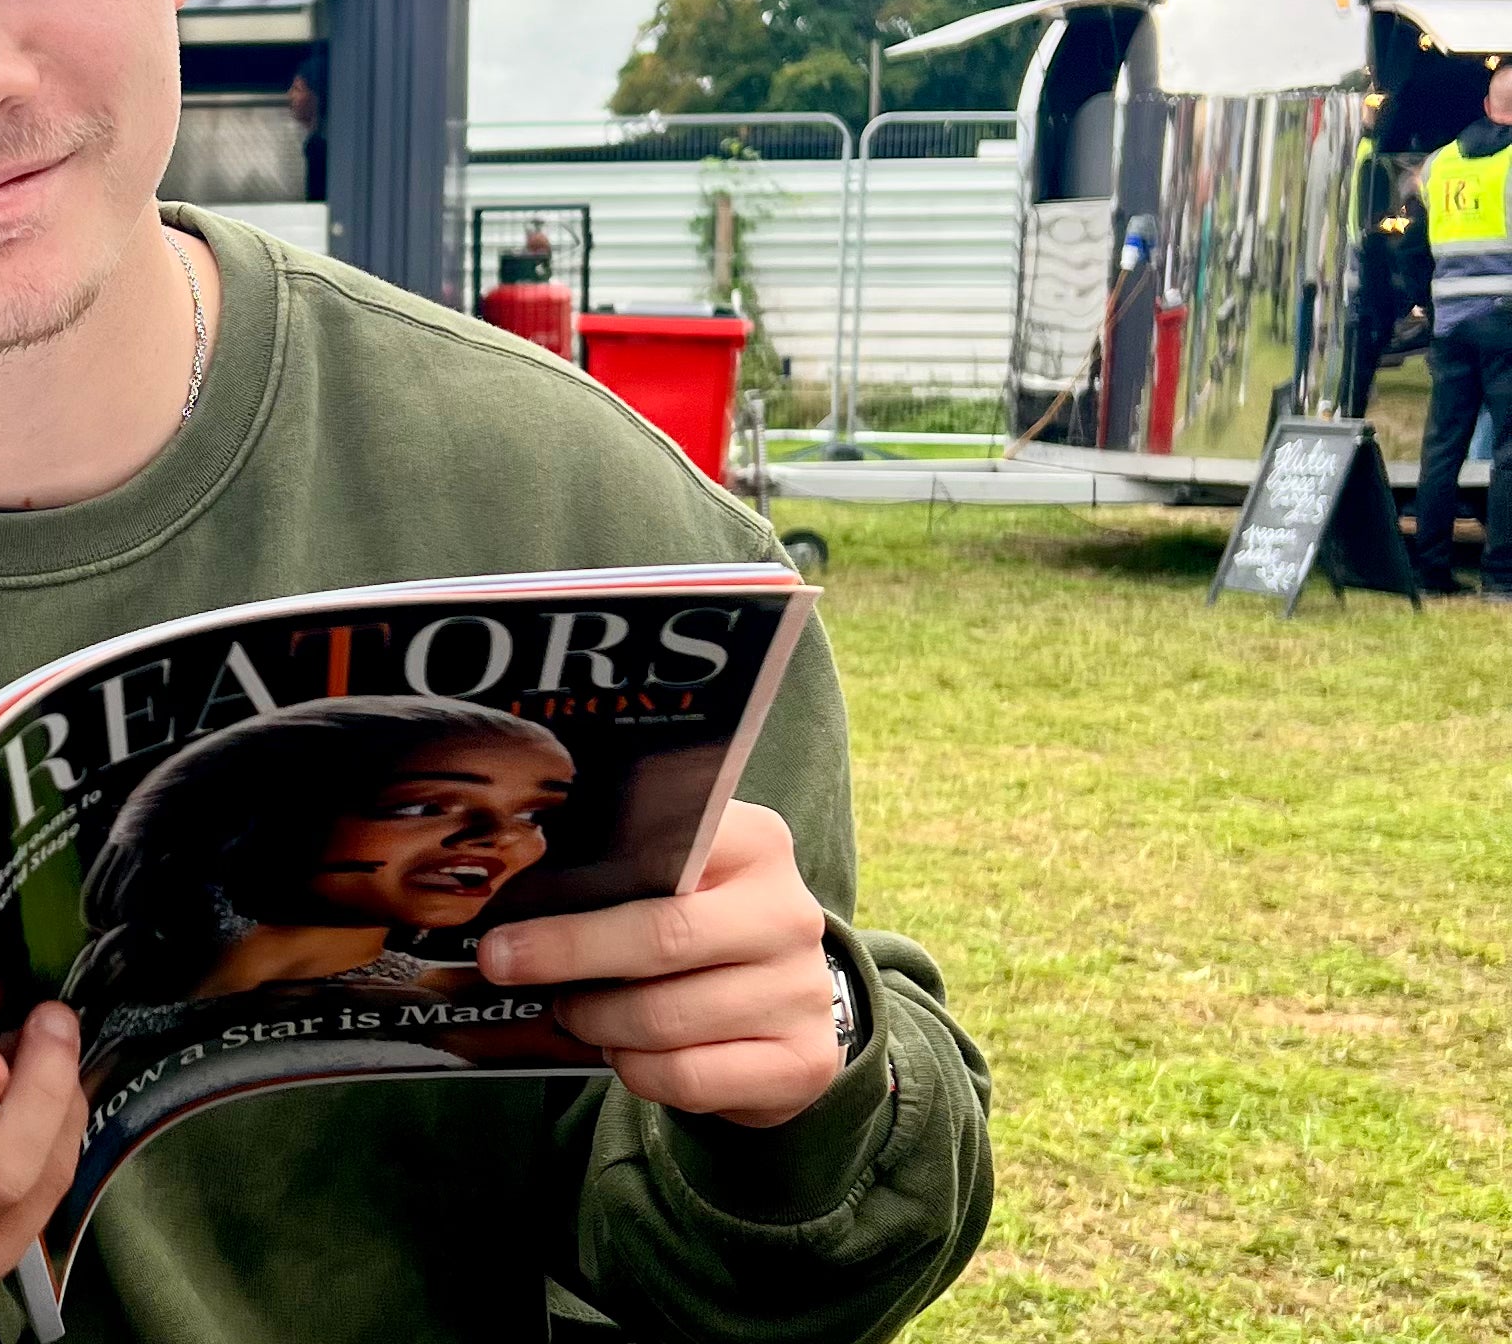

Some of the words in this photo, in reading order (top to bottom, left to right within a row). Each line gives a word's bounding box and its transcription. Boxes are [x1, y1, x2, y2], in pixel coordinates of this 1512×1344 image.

[81, 789, 102, 809] to
[29, 822, 80, 873] Stage
[81, 1058, 166, 1154] How
[180, 1043, 206, 1065] a
[221, 1012, 324, 1051] Star
[339, 1007, 381, 1030] is
[395, 998, 543, 1027] Made
